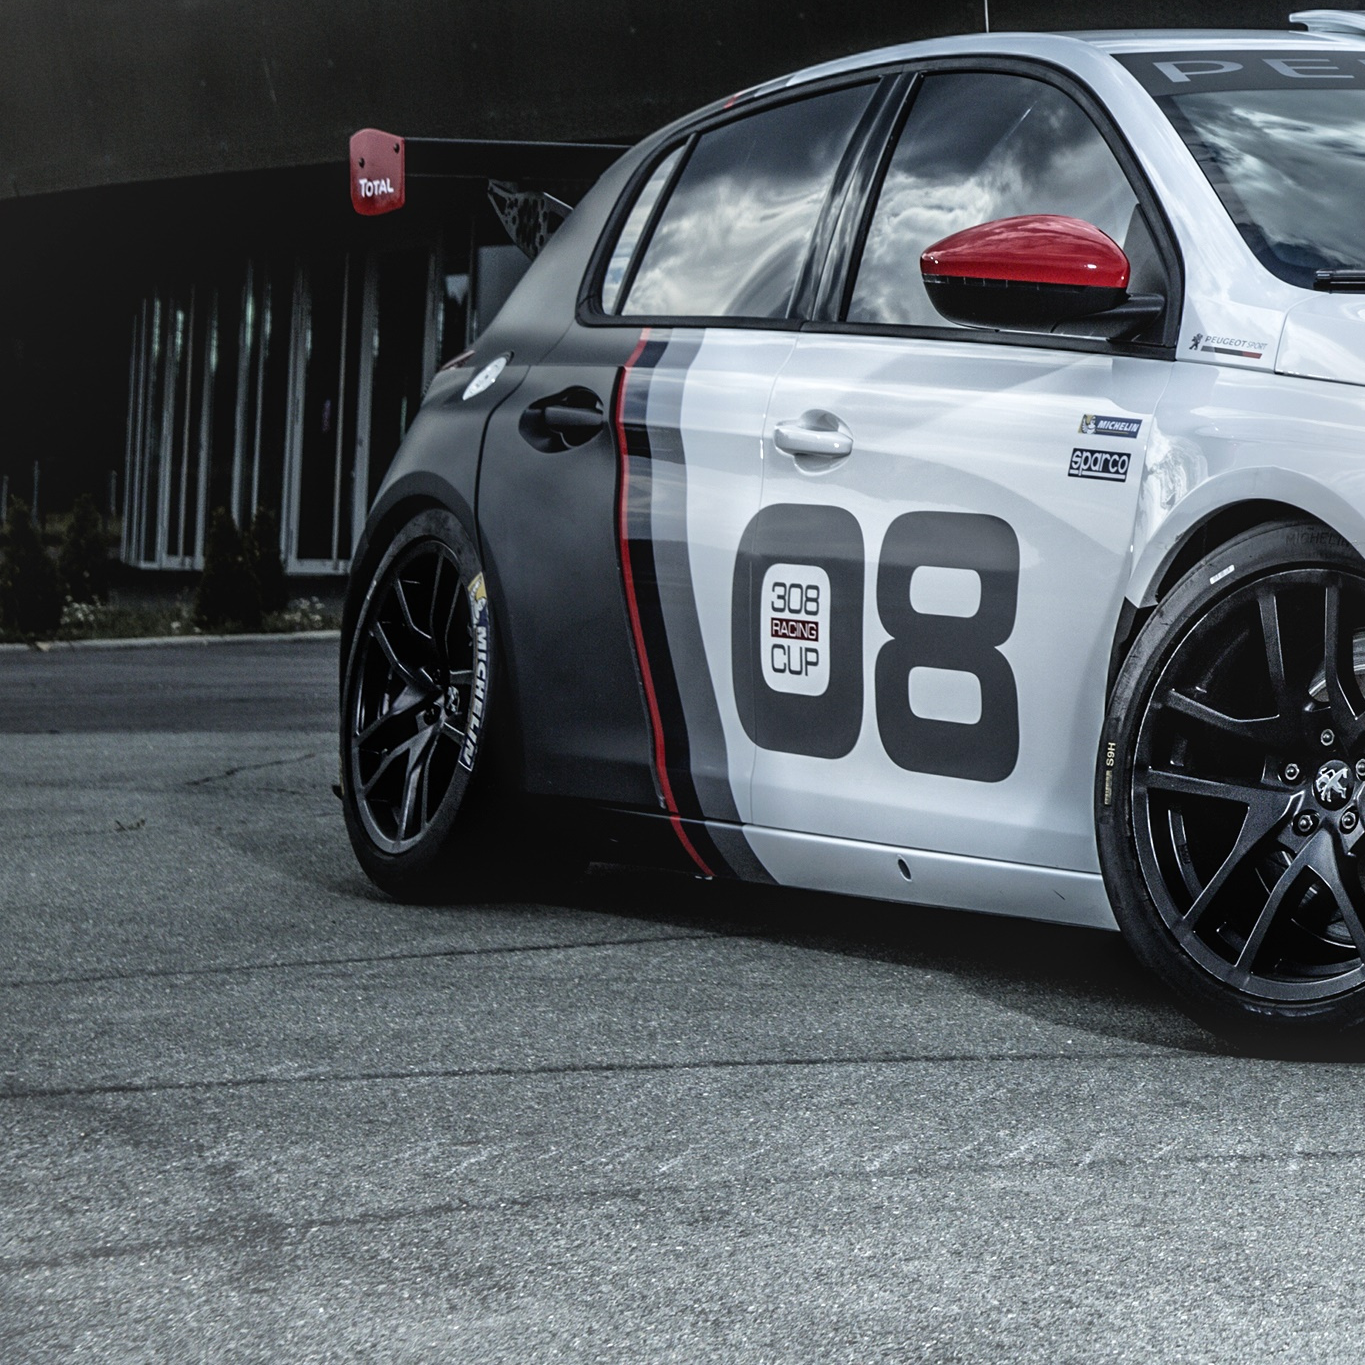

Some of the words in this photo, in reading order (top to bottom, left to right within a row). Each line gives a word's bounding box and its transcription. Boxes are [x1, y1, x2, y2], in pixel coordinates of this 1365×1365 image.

[359, 177, 394, 198] TOTAL
[1205, 336, 1247, 347] PEUGEOT
[1246, 341, 1268, 350] SPORT
[1097, 420, 1139, 432] MICHELIN
[1071, 450, 1128, 476] sparco
[771, 582, 820, 616] 308
[772, 620, 817, 639] RACING
[731, 502, 1020, 783] 08
[771, 643, 820, 676] CUP
[463, 626, 488, 766] MICHELIN
[1106, 742, 1116, 767] S9H
